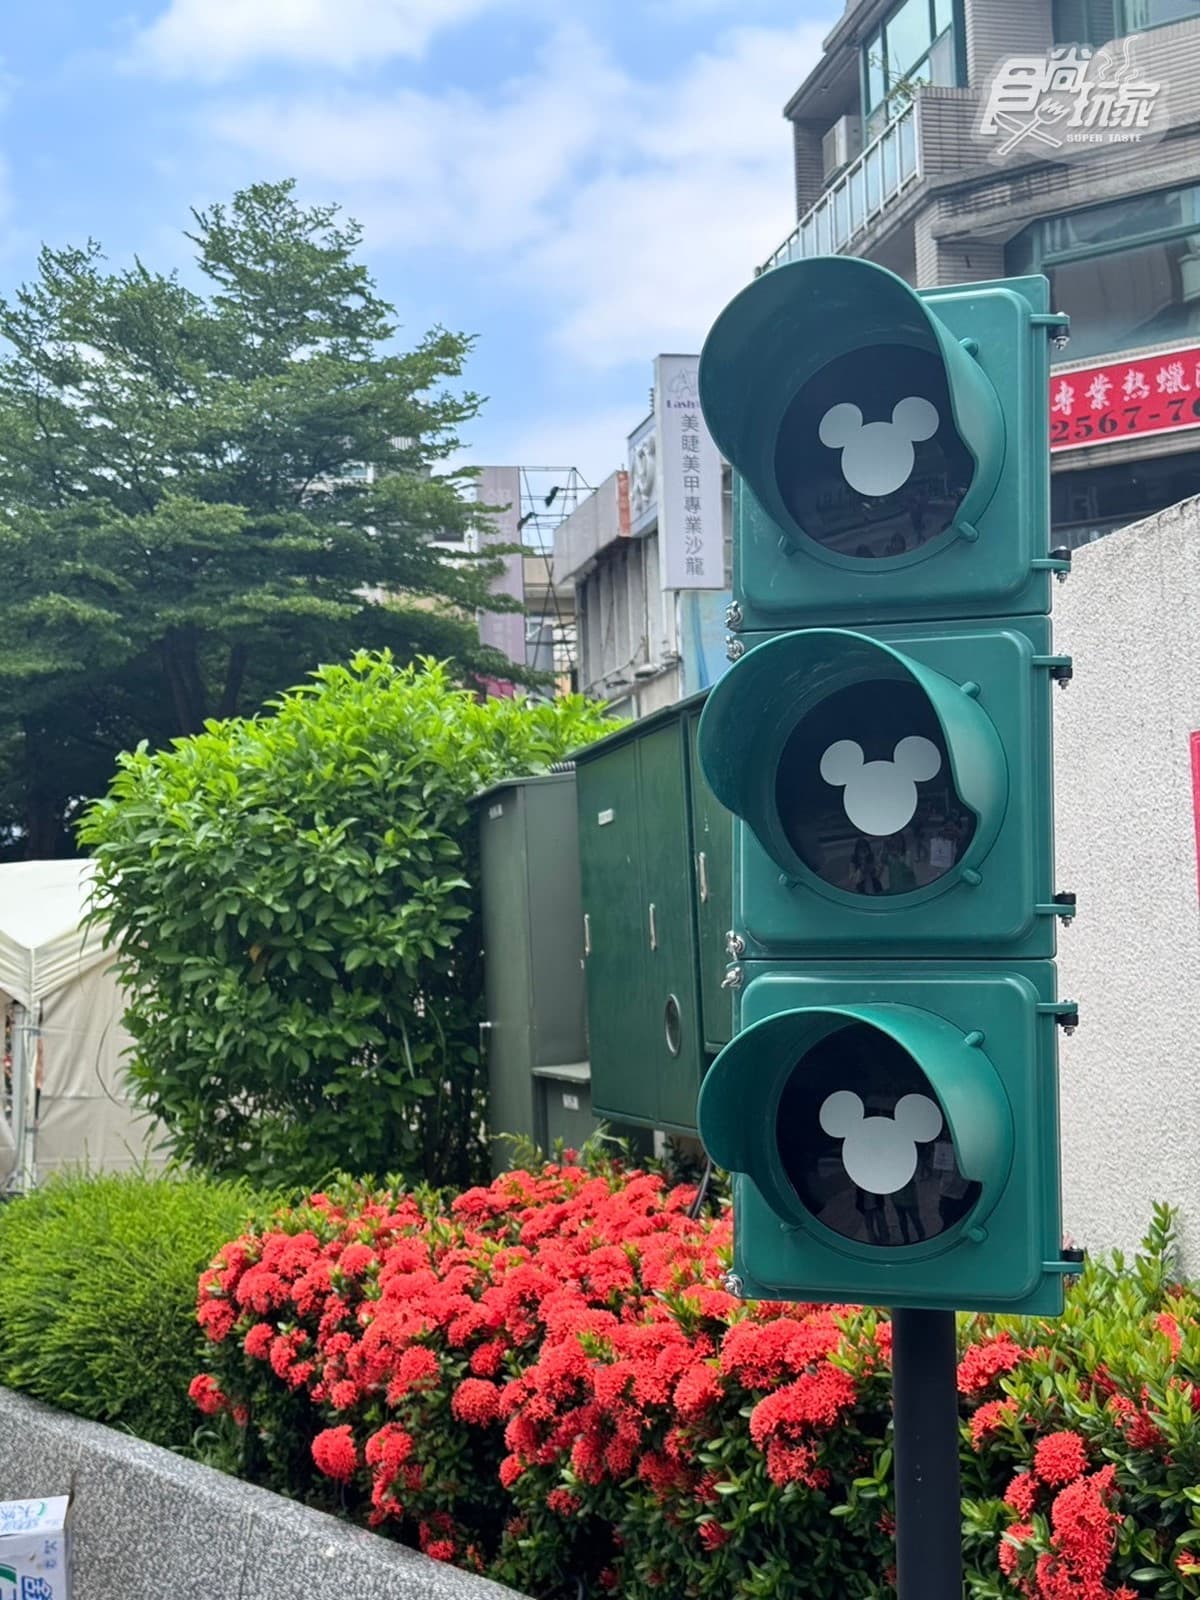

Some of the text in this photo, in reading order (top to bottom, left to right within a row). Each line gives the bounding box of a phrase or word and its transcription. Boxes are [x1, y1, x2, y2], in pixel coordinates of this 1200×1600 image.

[681, 414, 704, 576] 美睫美甲專業沙龍
